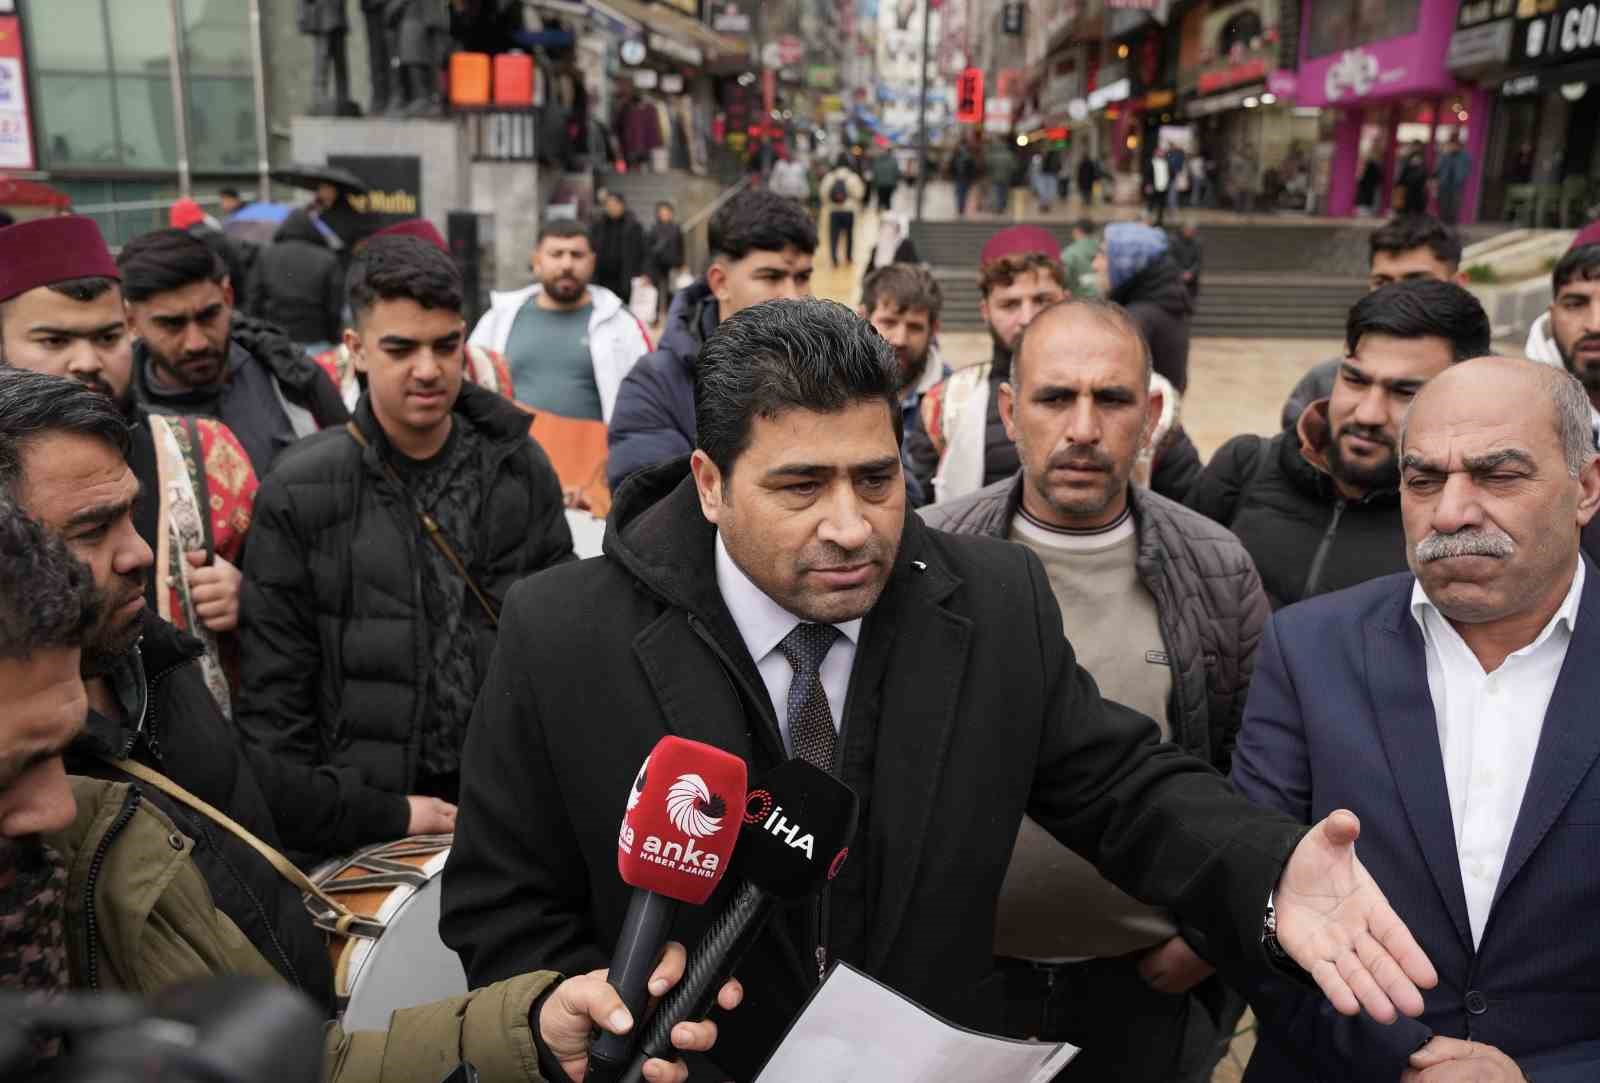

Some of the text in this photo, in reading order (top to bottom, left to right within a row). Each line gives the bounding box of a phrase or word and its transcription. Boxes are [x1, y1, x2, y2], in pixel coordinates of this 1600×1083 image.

[763, 806, 814, 860] İHA
[640, 852, 676, 869] HABER
[642, 836, 720, 871] anka
